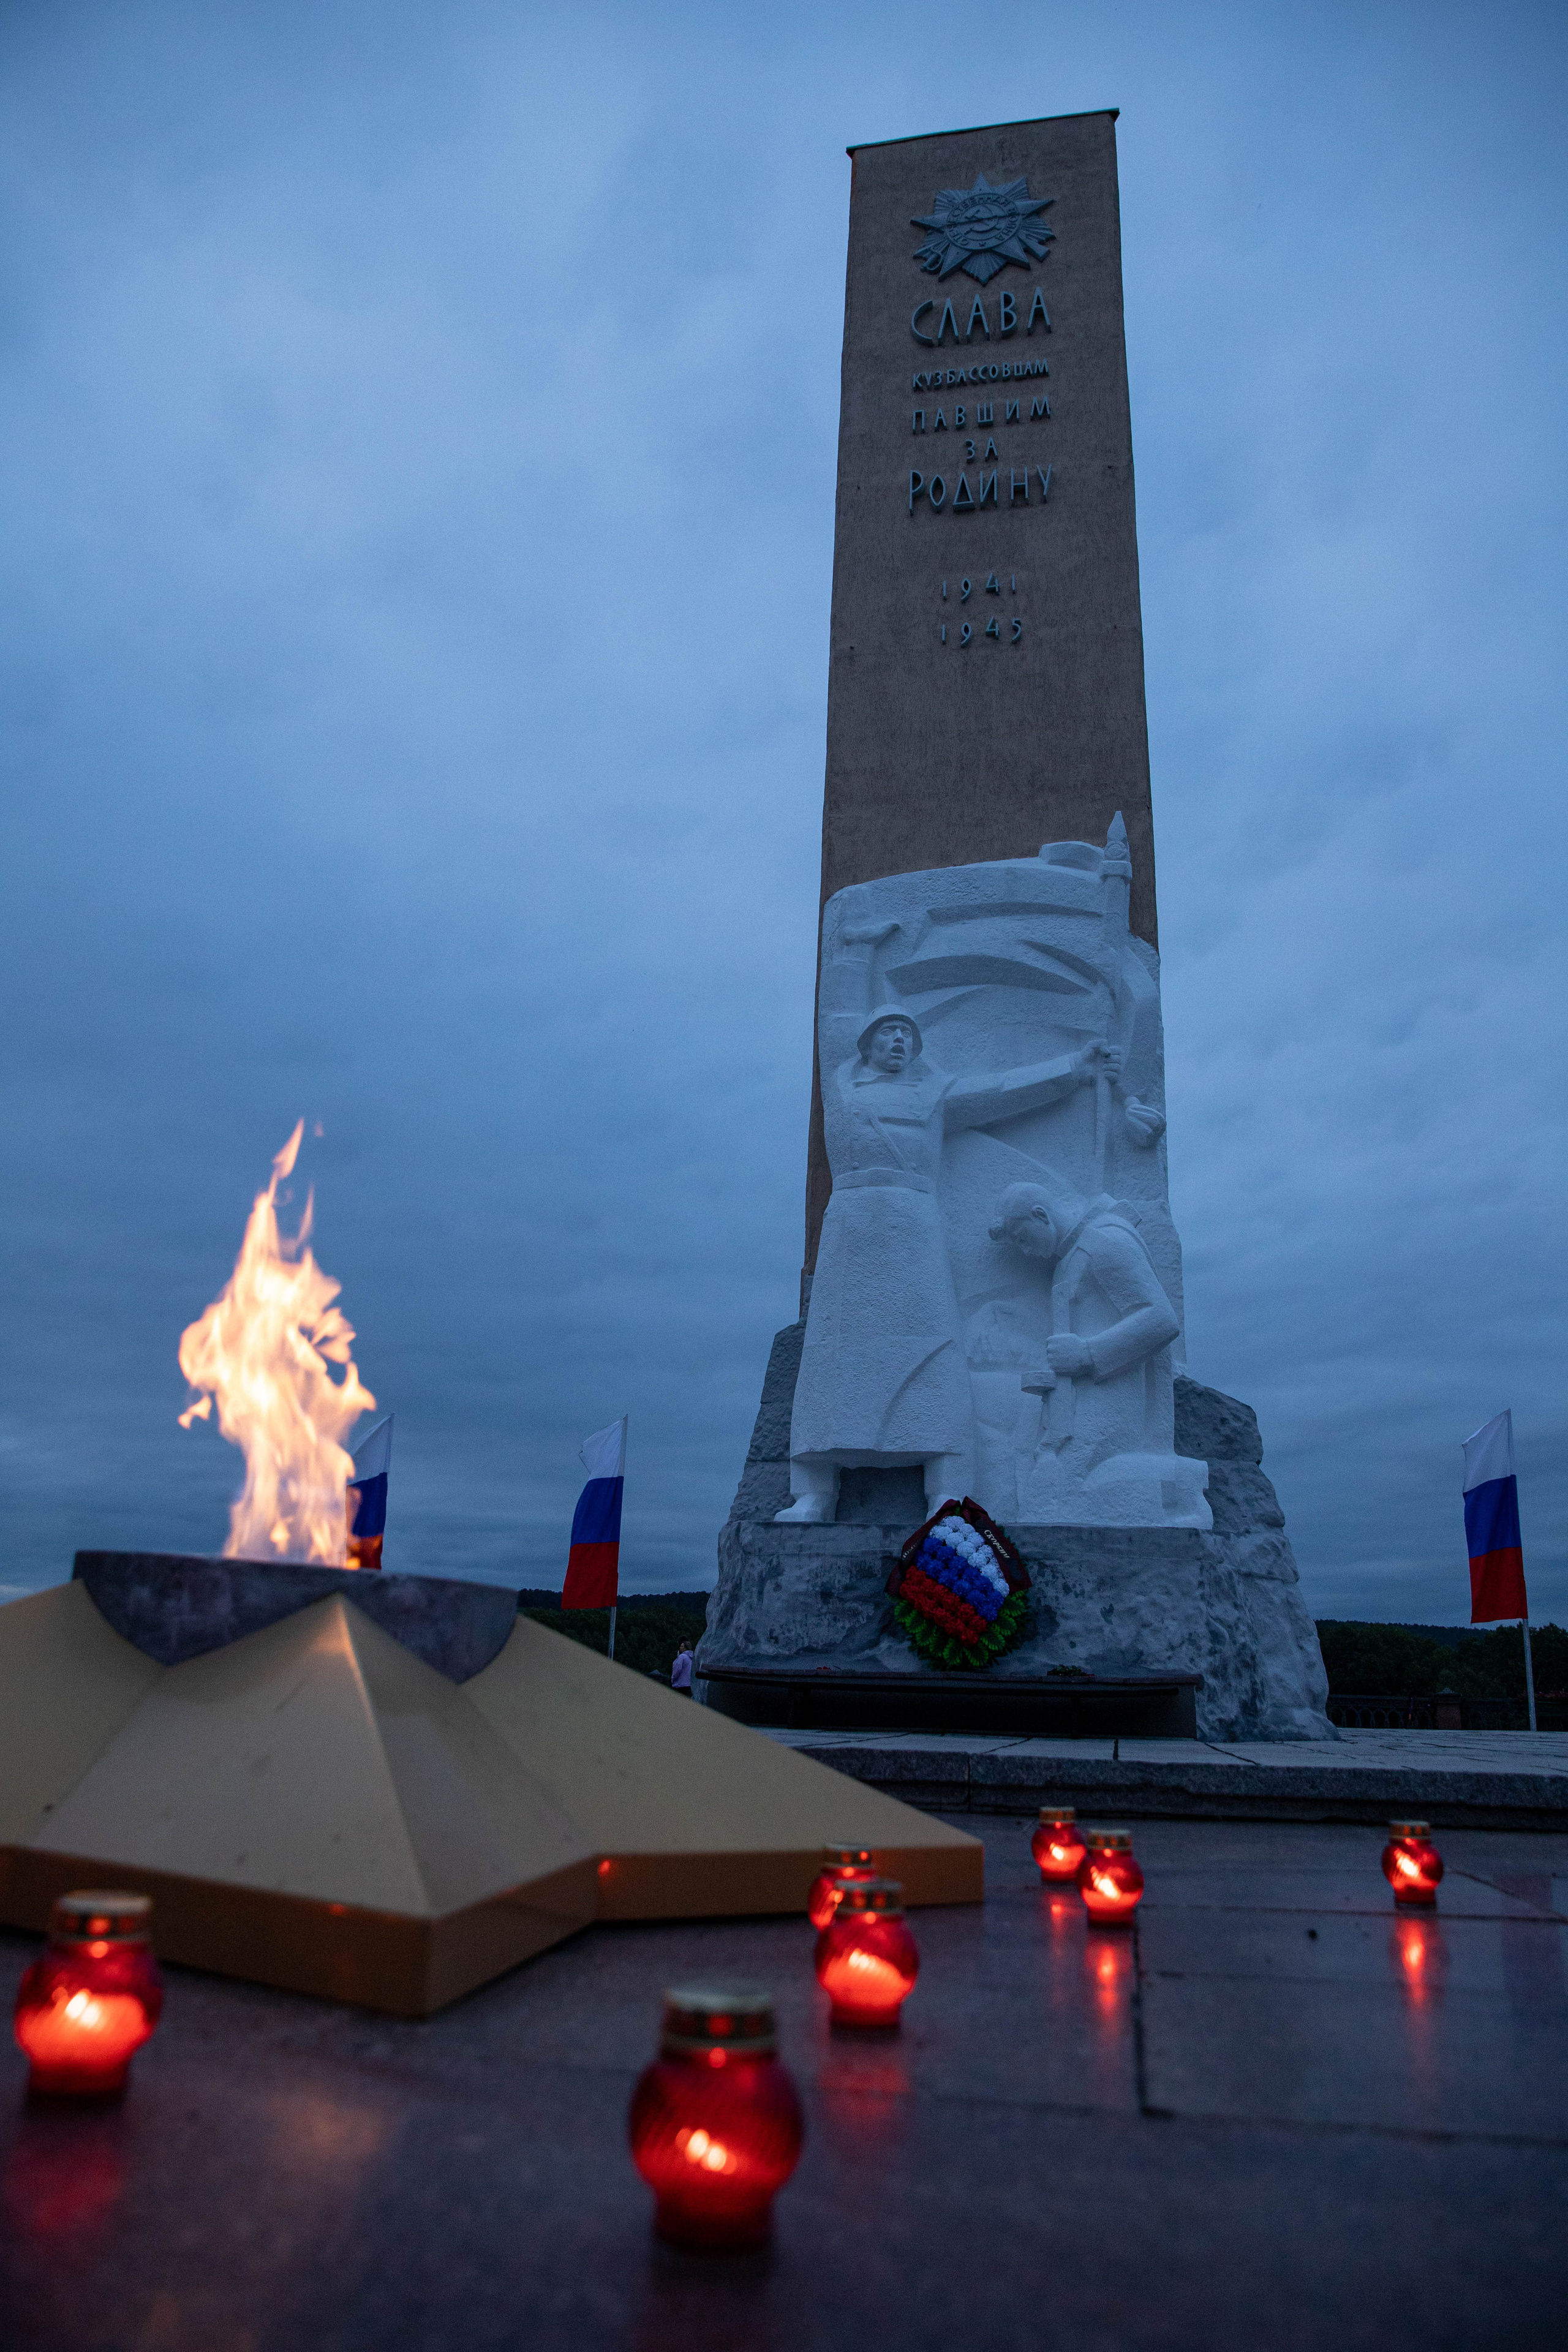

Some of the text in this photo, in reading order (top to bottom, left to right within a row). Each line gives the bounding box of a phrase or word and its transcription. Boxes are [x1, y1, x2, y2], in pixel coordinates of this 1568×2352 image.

[911, 286, 1051, 346] СЛАВА
[912, 358, 1049, 391] КУЗБАССОВЦАМ
[913, 396, 1050, 433] ПАВШИМ
[966, 437, 998, 462] ЗА
[910, 464, 1051, 515] РОДИНУ
[942, 573, 1016, 603] 1941
[941, 616, 1021, 647] 1945
